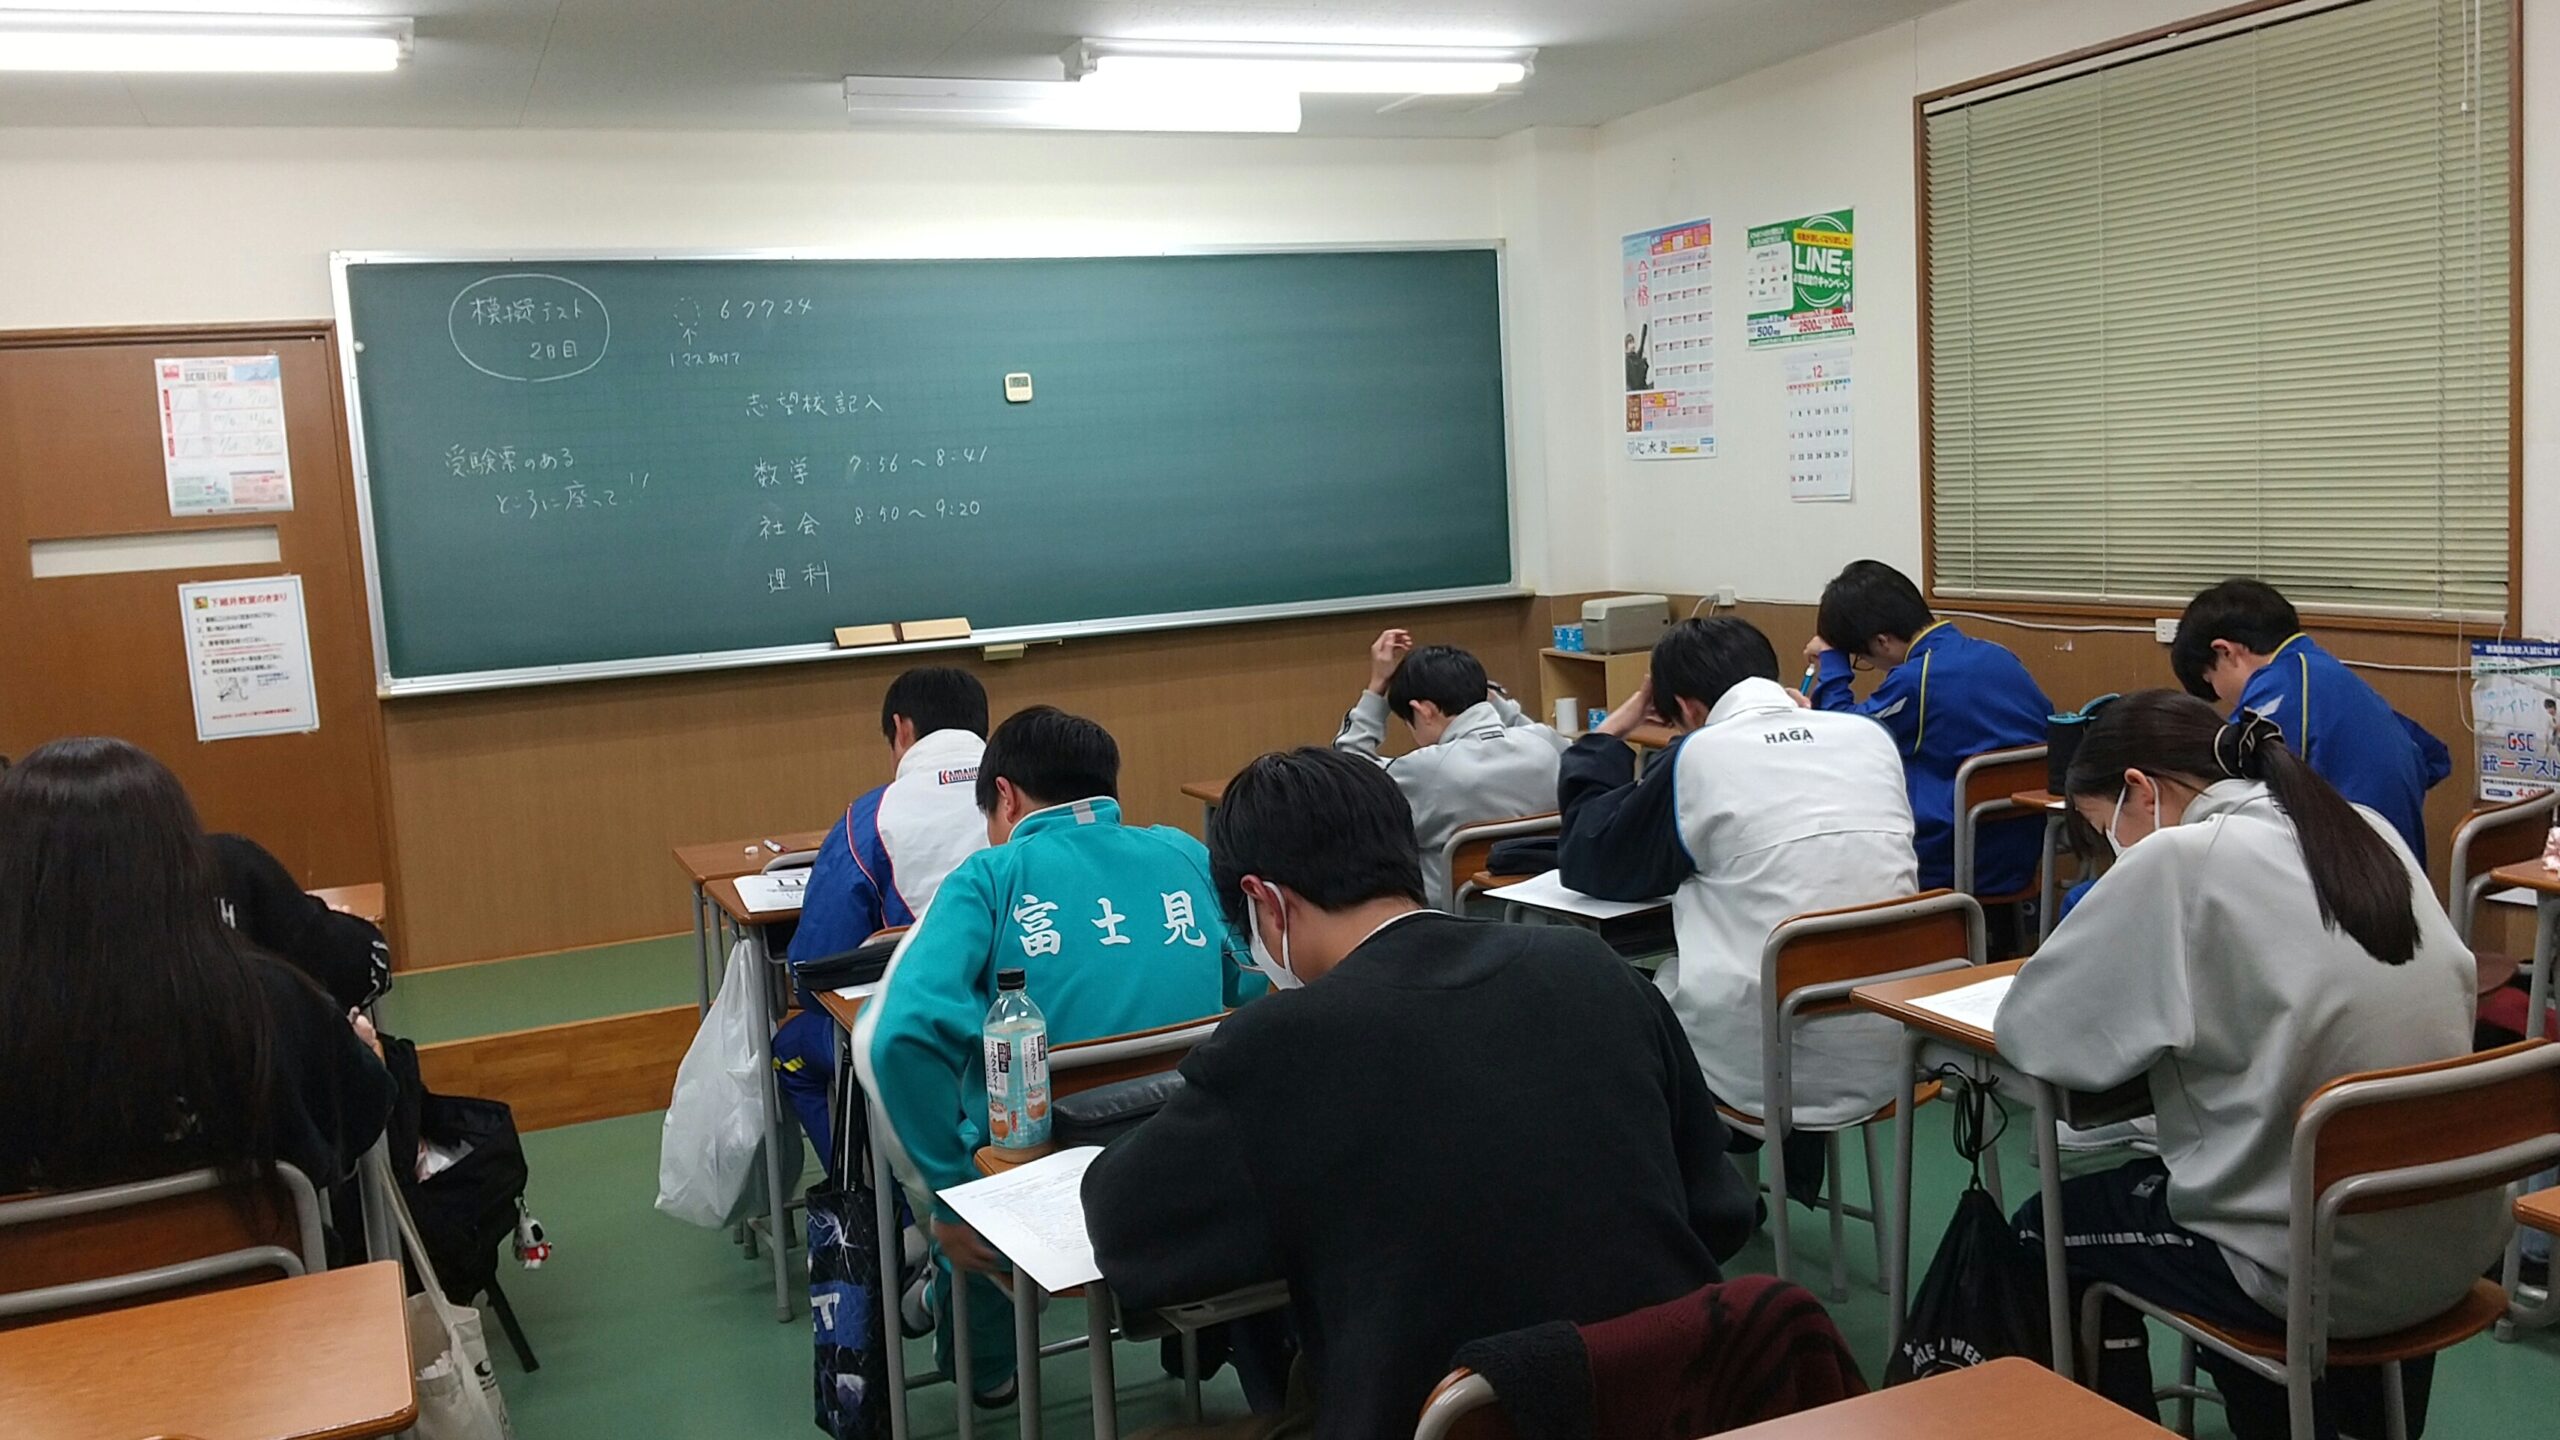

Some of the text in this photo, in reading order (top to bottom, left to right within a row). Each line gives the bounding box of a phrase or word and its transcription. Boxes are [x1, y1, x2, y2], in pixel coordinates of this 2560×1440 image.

[1795, 245, 1852, 276] LINEで
[469, 297, 583, 326] 模擬テスト
[529, 340, 577, 359] 2日目
[1813, 365, 1823, 378] 12
[745, 391, 883, 418] 志望校記入
[754, 456, 809, 487] 数学
[759, 511, 820, 540] 社会
[768, 560, 830, 594] 理科
[1764, 729, 1814, 744] HAGA
[2507, 732, 2535, 752] GSC
[2481, 753, 2560, 777] 統一テスト
[1012, 890, 1207, 957] 富士見
[990, 1041, 998, 1091] ミルクティー
